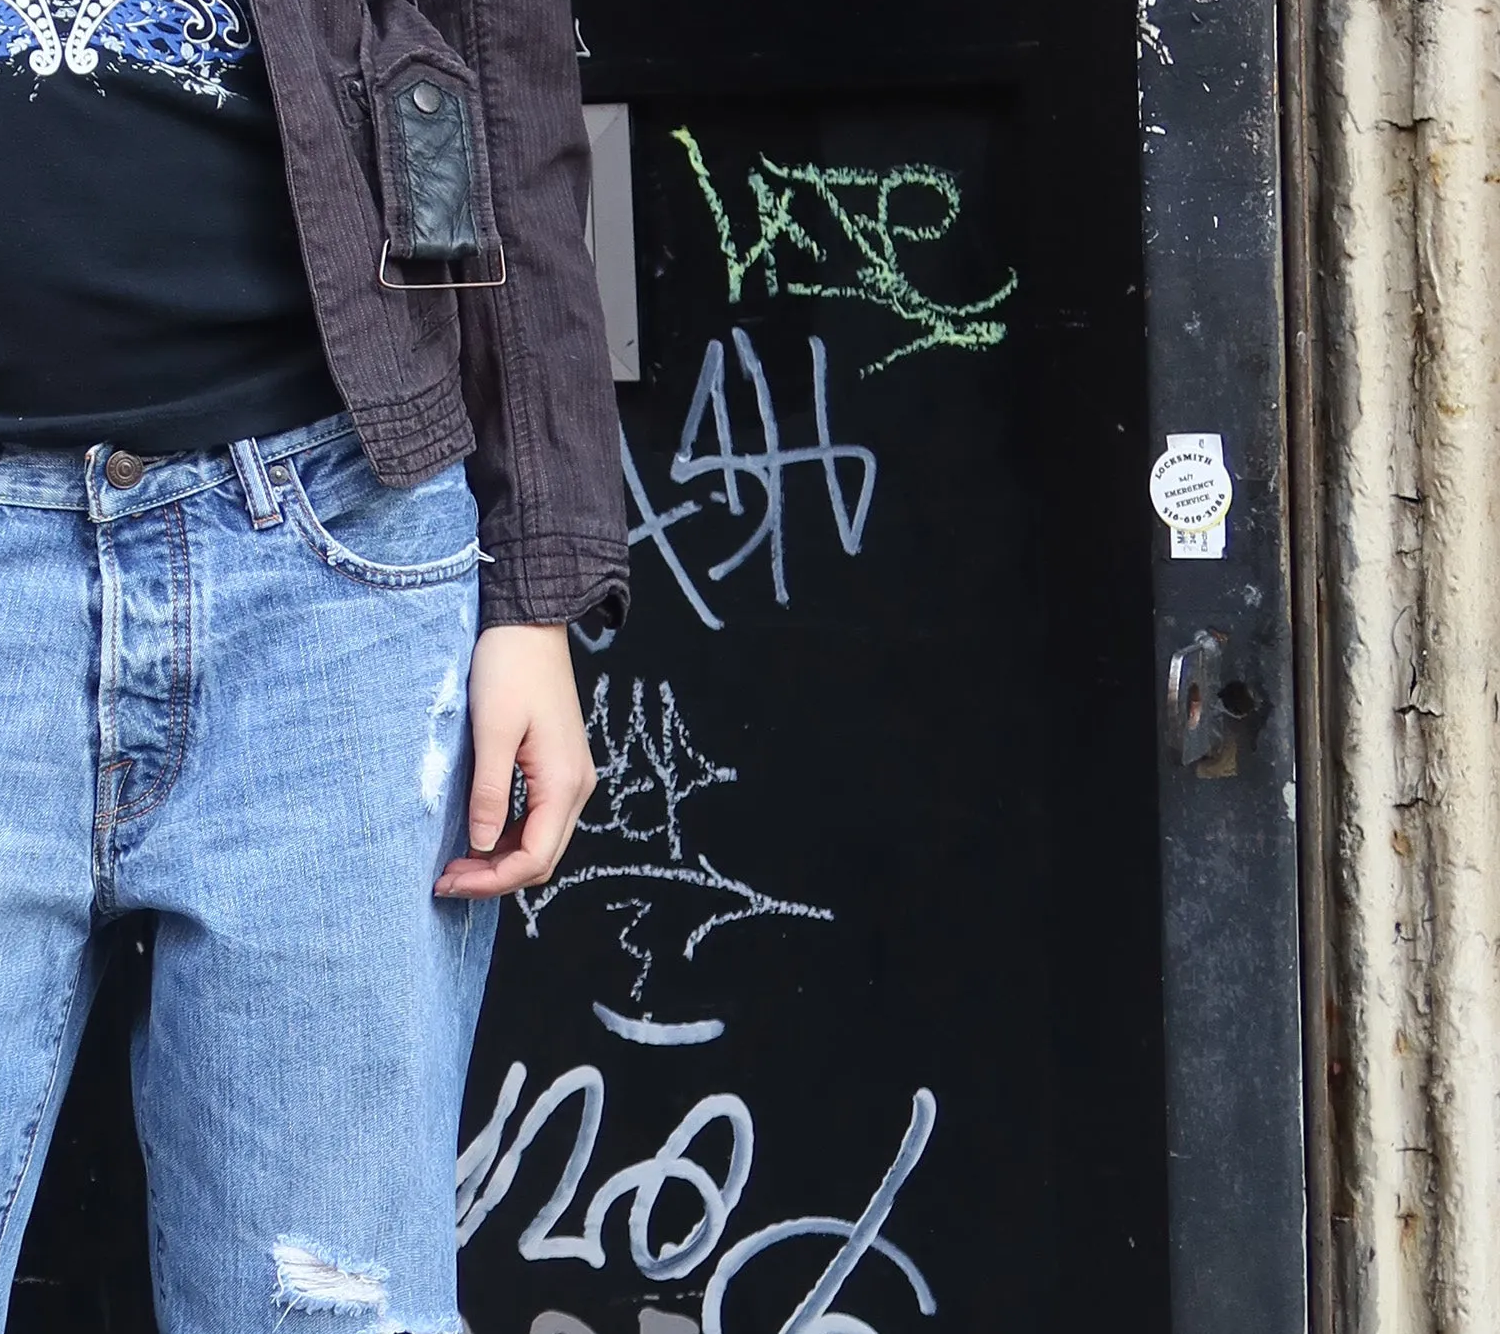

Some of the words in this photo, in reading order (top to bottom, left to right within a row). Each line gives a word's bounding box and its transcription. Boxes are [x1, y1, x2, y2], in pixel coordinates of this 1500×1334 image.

[1154, 453, 1213, 480] LOCKSMITH
[1164, 479, 1215, 499] EMERGENCY
[1175, 493, 1211, 509] SERVICE
